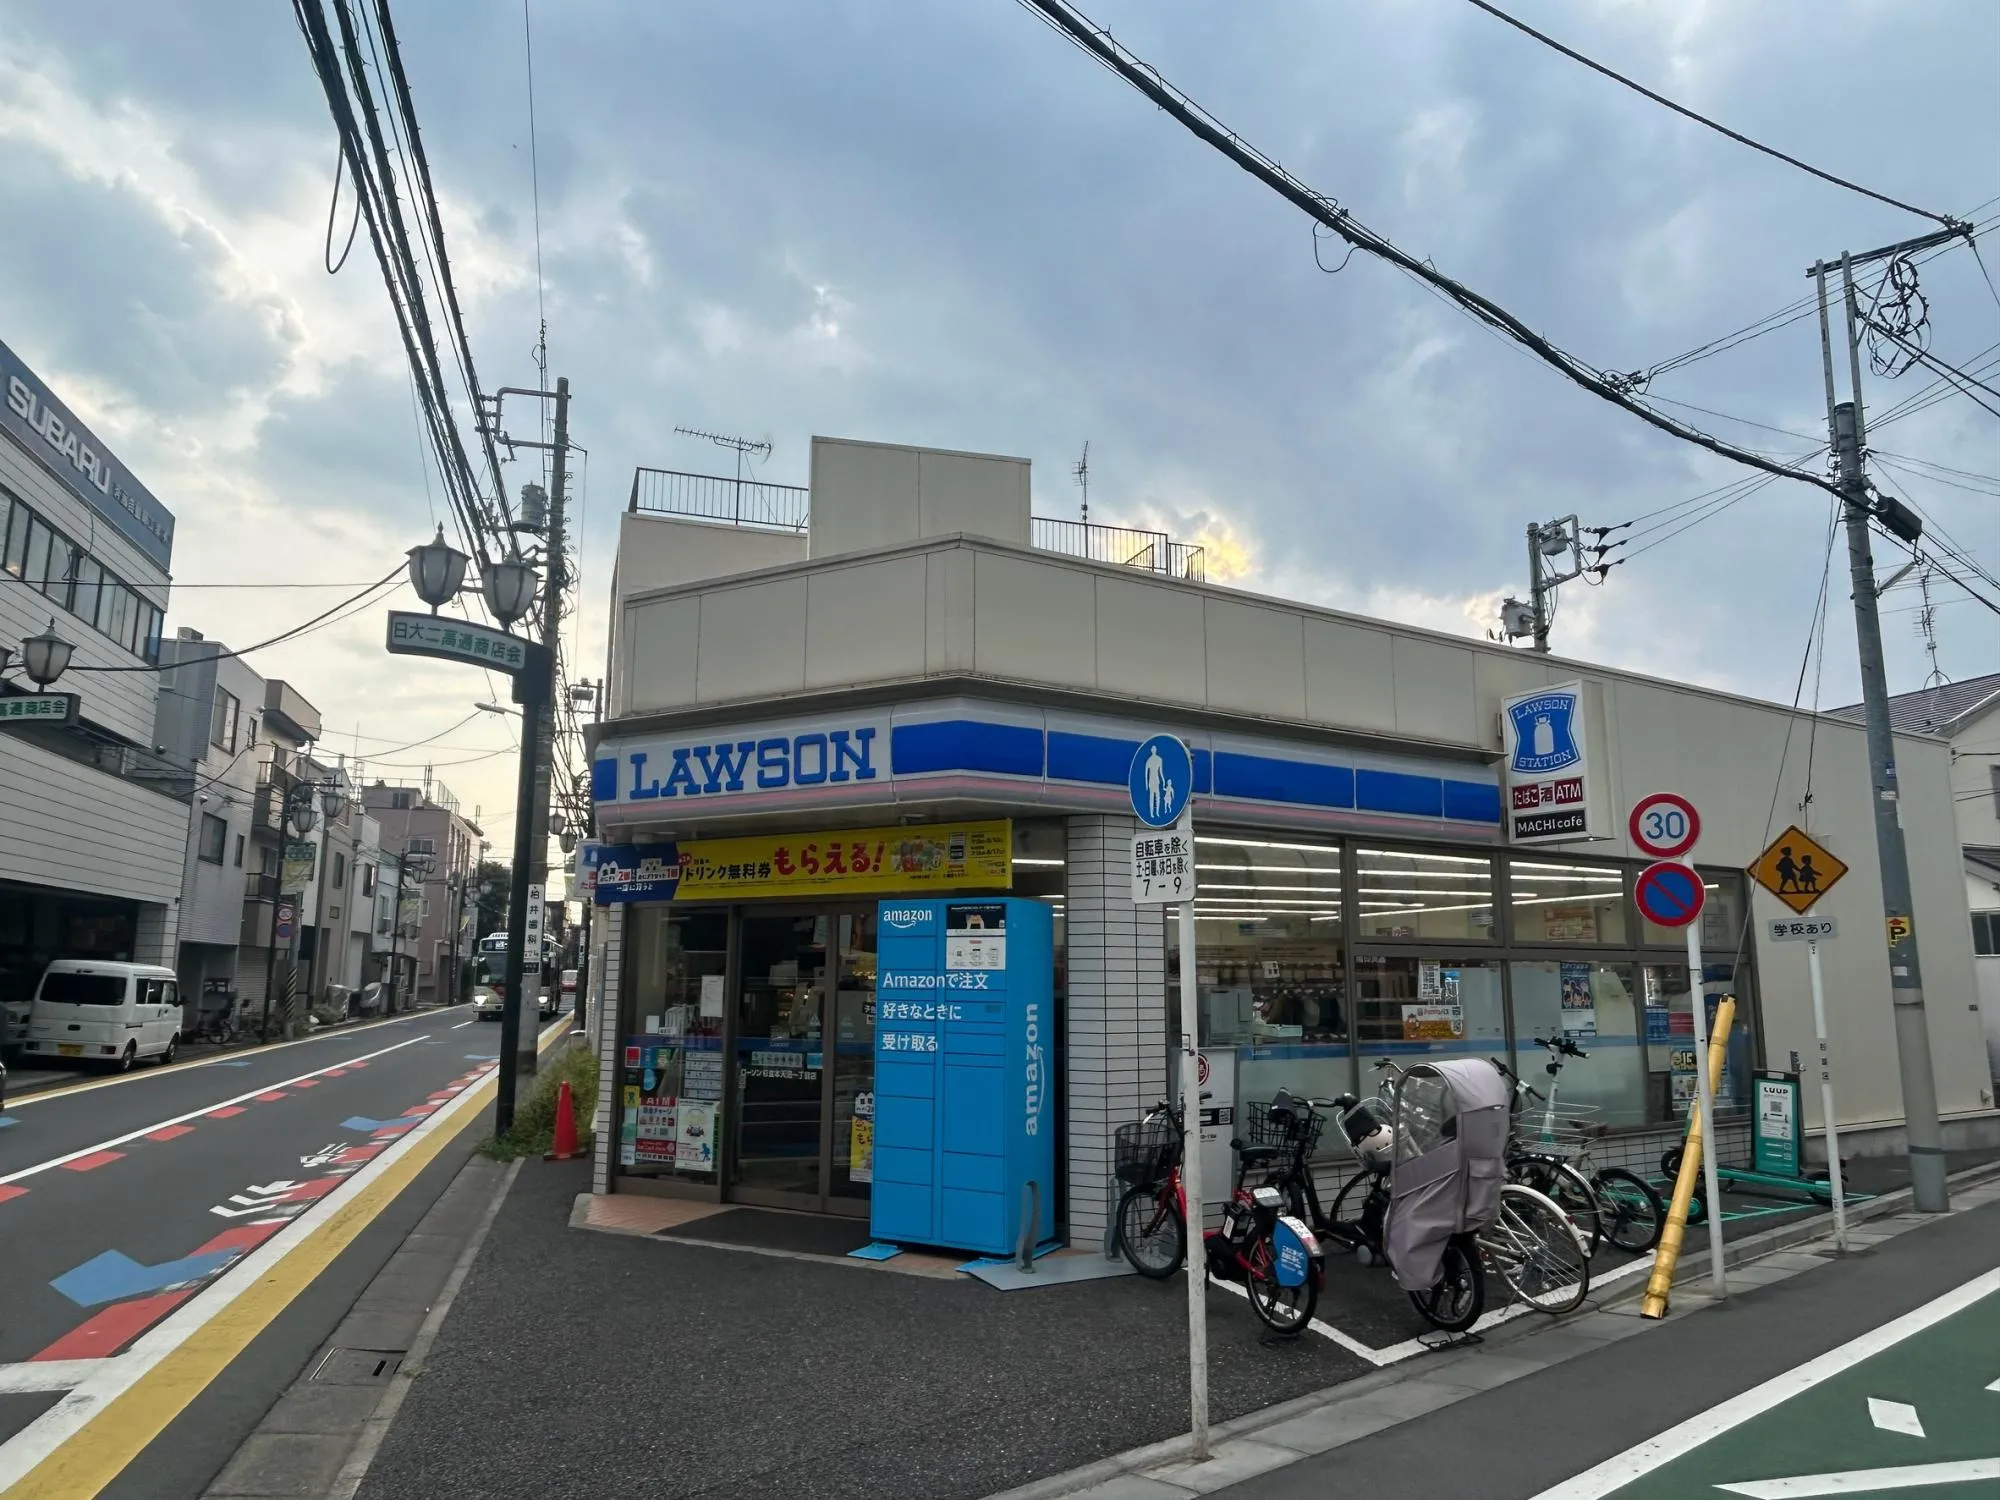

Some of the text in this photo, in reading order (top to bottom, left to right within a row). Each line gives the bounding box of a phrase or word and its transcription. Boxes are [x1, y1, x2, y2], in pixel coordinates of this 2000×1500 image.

[7, 374, 111, 495] SUBARU
[1514, 698, 1570, 719] LAWSON
[629, 727, 877, 800] LAWSON
[1518, 749, 1573, 769] STATION
[1556, 782, 1581, 800] ATM
[1517, 818, 1556, 833] MACHI
[1645, 811, 1686, 840] 30
[1135, 836, 1188, 857] 自転車を除く
[685, 862, 772, 882] ドリンク無料券
[883, 909, 932, 922] amazon
[1773, 922, 1832, 937] 学校あり
[1889, 926, 1907, 941] P
[883, 972, 989, 990] Amazonで注文
[882, 1002, 962, 1021] 好きなときに
[882, 1033, 938, 1052] 受け取る
[1025, 1003, 1039, 1137] amazon
